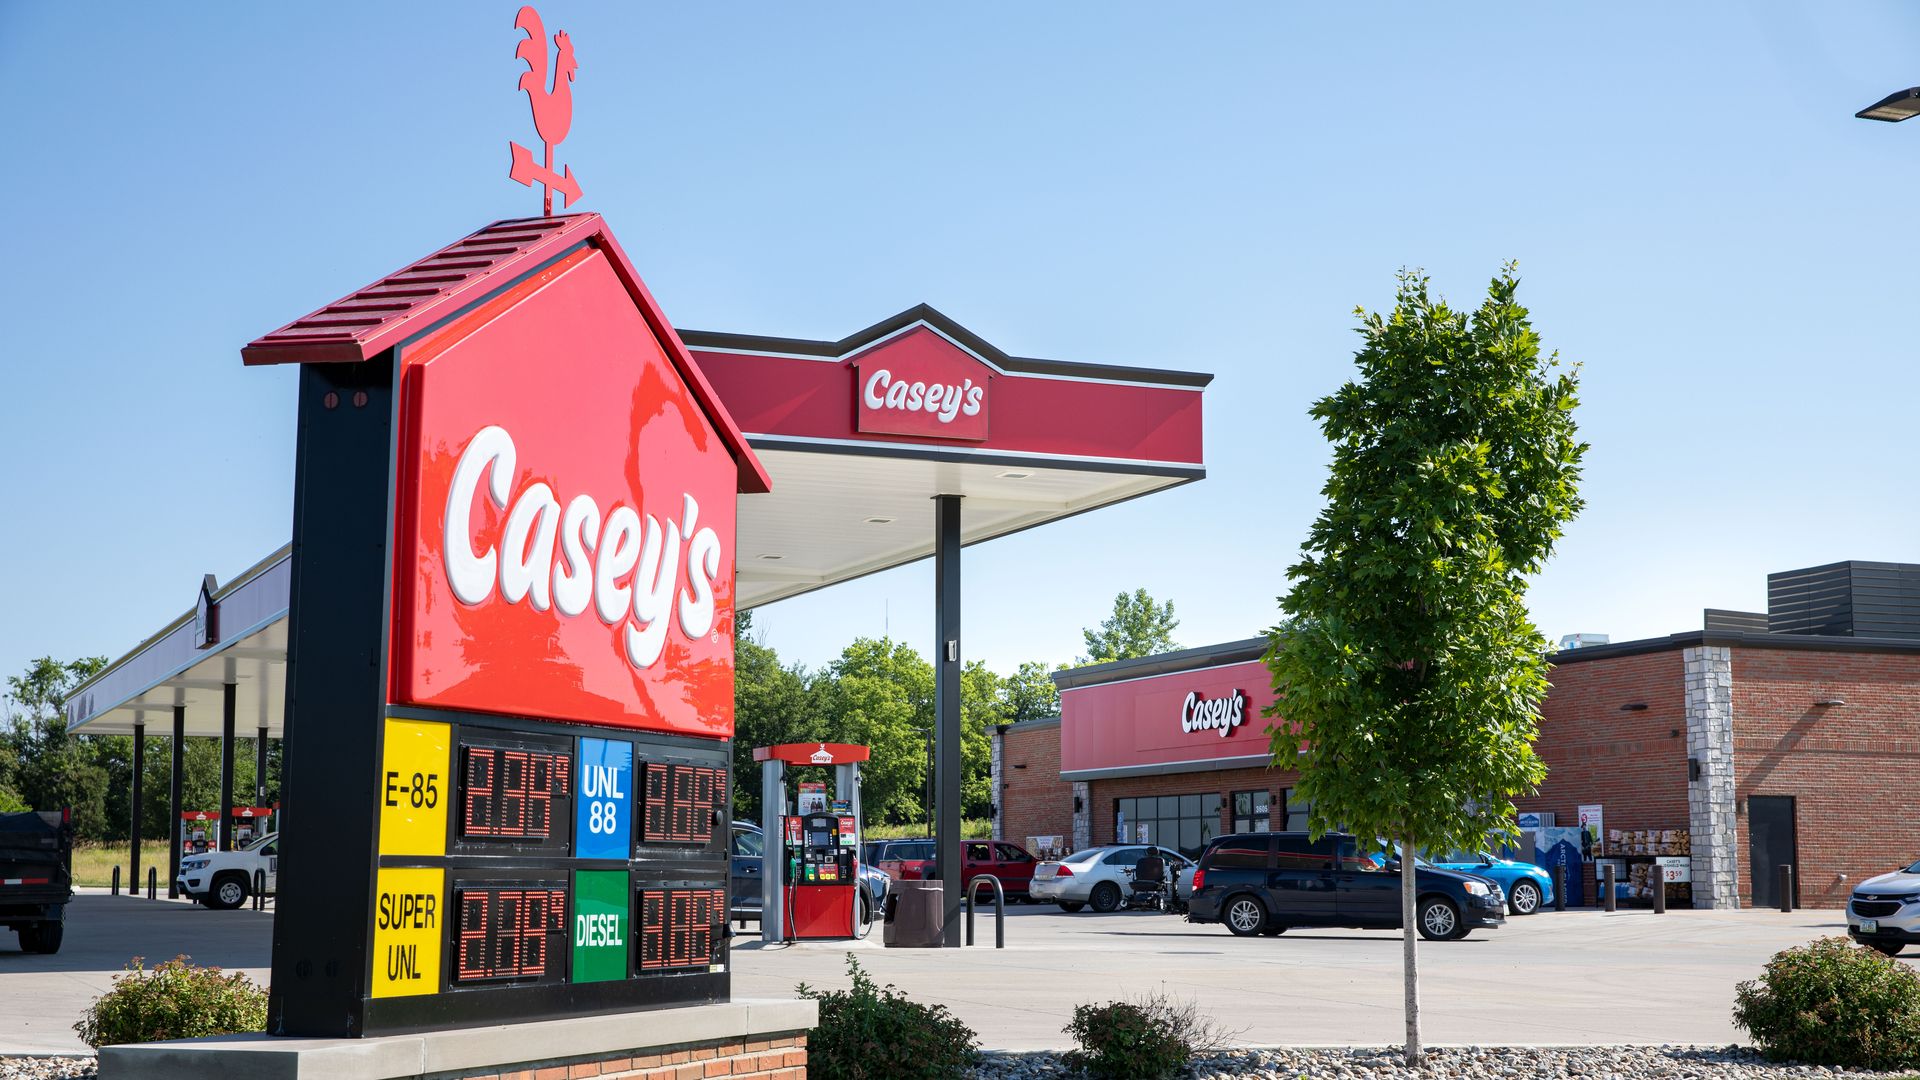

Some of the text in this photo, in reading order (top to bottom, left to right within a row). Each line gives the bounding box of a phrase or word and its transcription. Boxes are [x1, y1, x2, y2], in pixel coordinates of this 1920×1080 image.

[864, 369, 983, 423] Casey's
[444, 425, 721, 669] Casey's
[1182, 688, 1244, 738] Casey's
[386, 771, 438, 809] E-85
[584, 765, 624, 799] UNL
[589, 801, 617, 834] 88
[378, 892, 435, 930] SUPER
[576, 914, 623, 947] DIESEL
[388, 944, 421, 981] UNL
